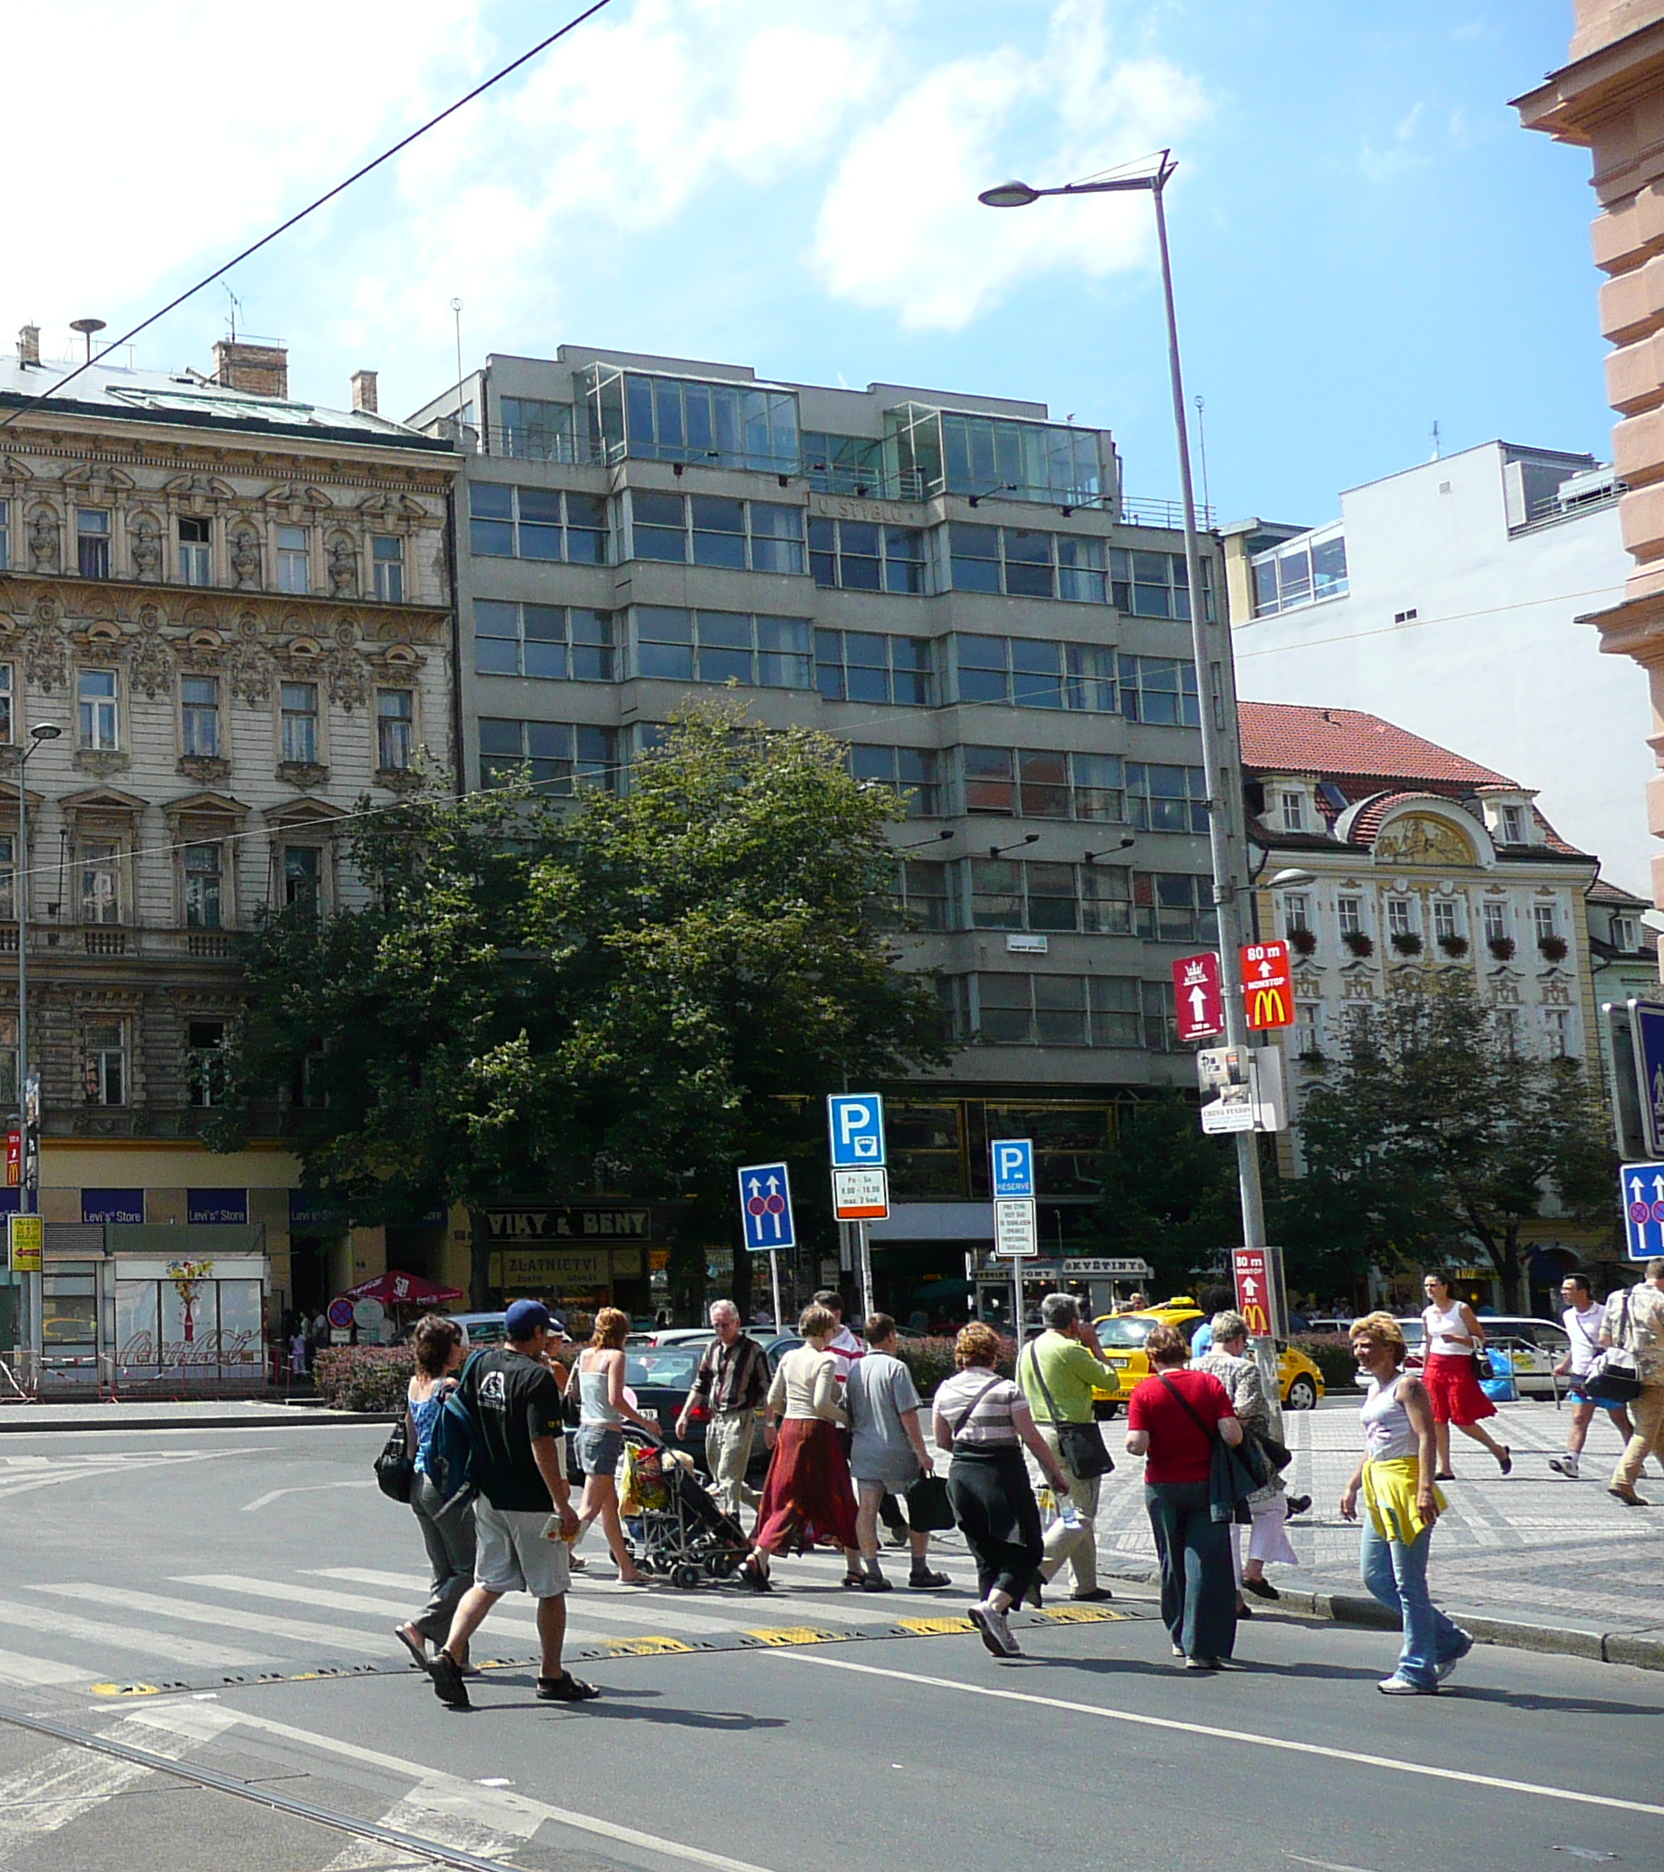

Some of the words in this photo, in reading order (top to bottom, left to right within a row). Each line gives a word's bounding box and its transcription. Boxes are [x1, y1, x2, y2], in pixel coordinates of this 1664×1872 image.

[1248, 946, 1264, 961] 80
[1267, 947, 1280, 958] m
[840, 1104, 870, 1144] P
[1001, 1148, 1023, 1179] P
[116, 1210, 141, 1223] Store
[221, 1210, 245, 1222] Store
[487, 1212, 548, 1235] VIKY
[582, 1212, 647, 1235] BENY
[1250, 1257, 1262, 1267] m
